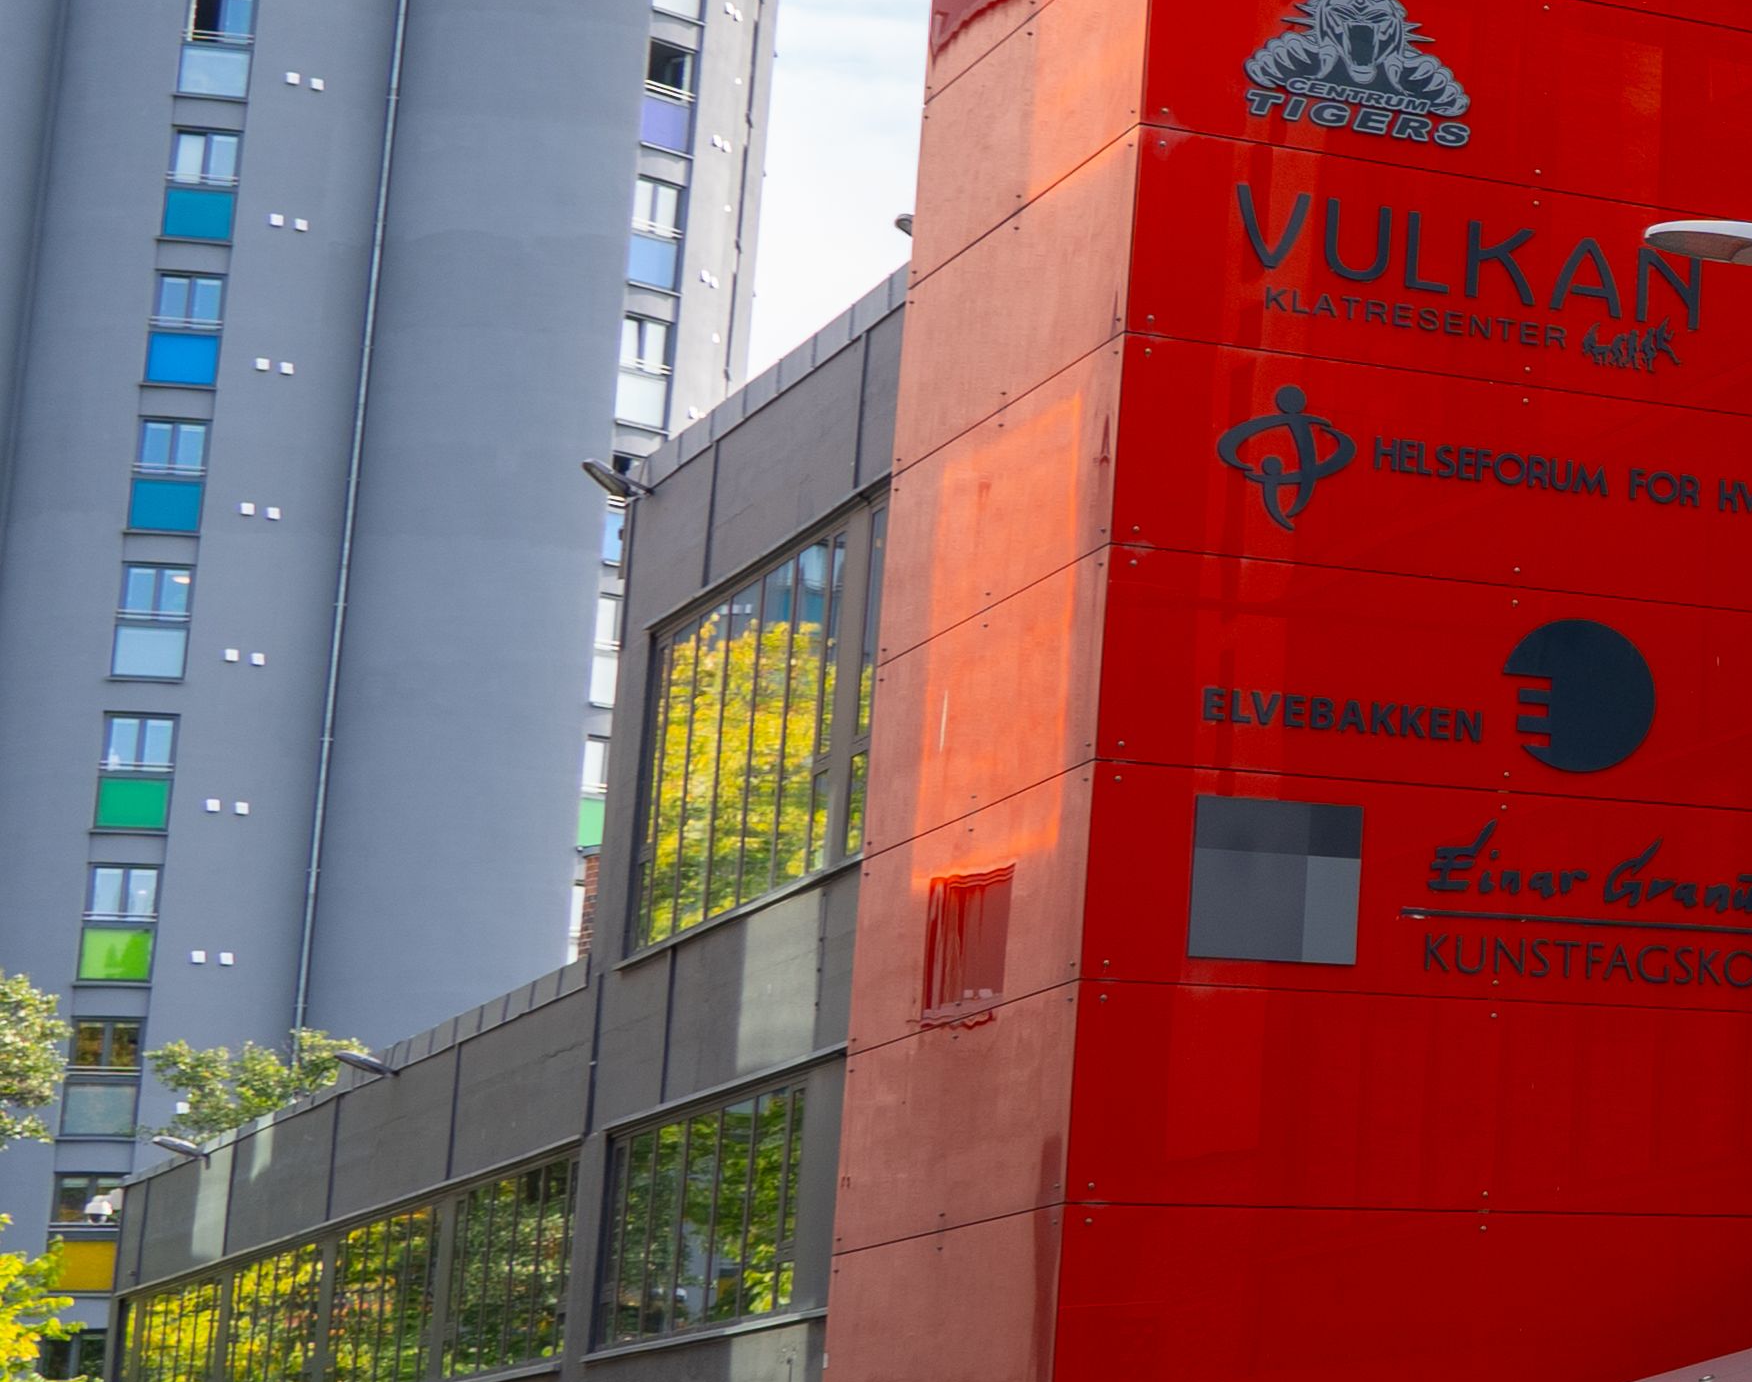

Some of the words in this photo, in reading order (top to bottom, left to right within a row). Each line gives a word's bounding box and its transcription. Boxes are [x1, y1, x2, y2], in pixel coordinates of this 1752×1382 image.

[1245, 89, 1470, 148] TIGERS
[1284, 76, 1430, 115] CENTRUM
[1237, 184, 1702, 331] VULKAN
[1264, 287, 1567, 350] KLATRESENTER
[1373, 436, 1609, 497] HELSEFORUM
[1629, 469, 1699, 507] FOR
[1202, 687, 1483, 743] ELVEBAKKEN
[1427, 820, 1588, 896] Einar
